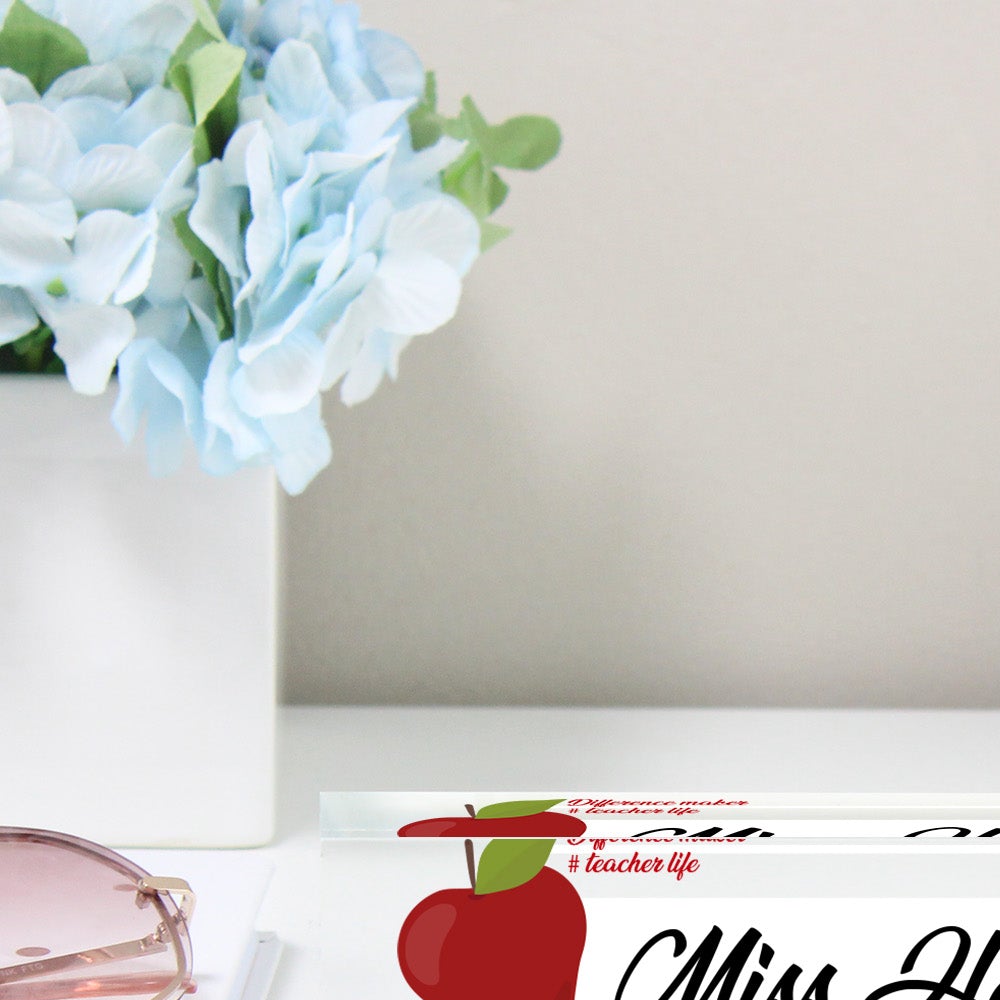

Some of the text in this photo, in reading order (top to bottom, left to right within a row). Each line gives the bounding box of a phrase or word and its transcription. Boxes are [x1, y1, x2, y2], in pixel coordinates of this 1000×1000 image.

[567, 851, 700, 881] # teacher life
